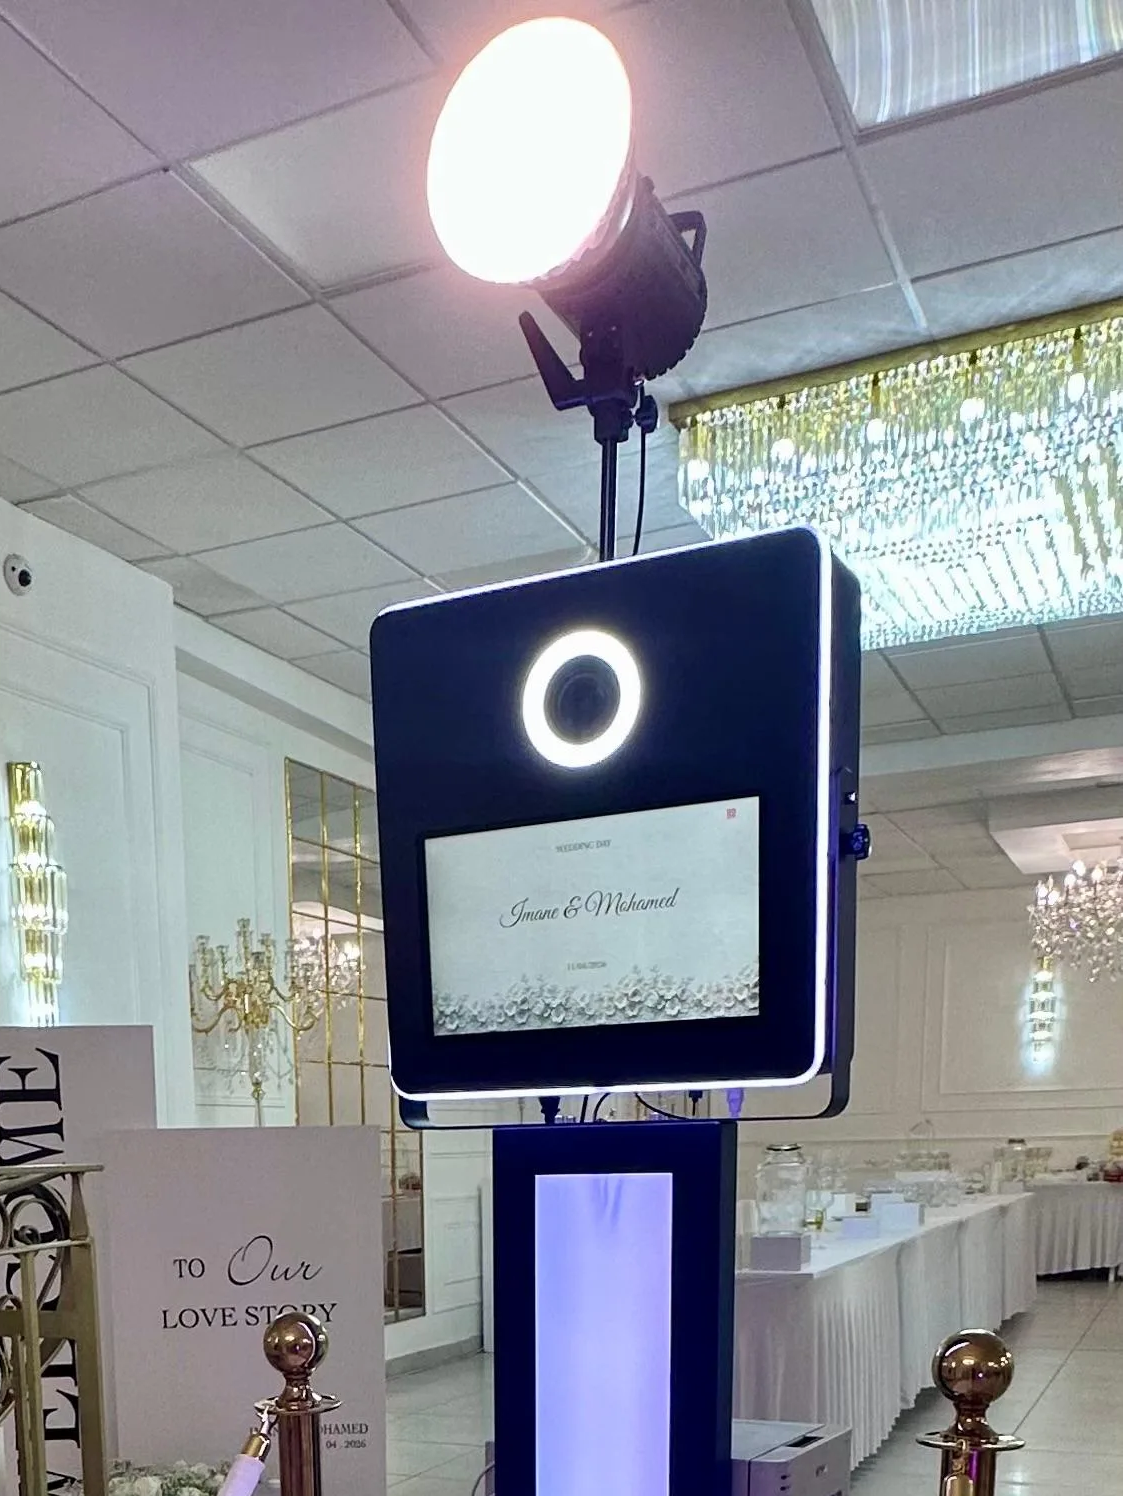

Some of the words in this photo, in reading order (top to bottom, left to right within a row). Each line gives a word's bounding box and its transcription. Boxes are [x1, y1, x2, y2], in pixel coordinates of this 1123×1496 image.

[499, 897, 559, 928] Imane
[564, 895, 582, 919] &
[585, 888, 680, 917] Mohamed
[173, 1258, 205, 1278] TO
[228, 1235, 323, 1286] Our
[162, 1306, 238, 1329] LOVE
